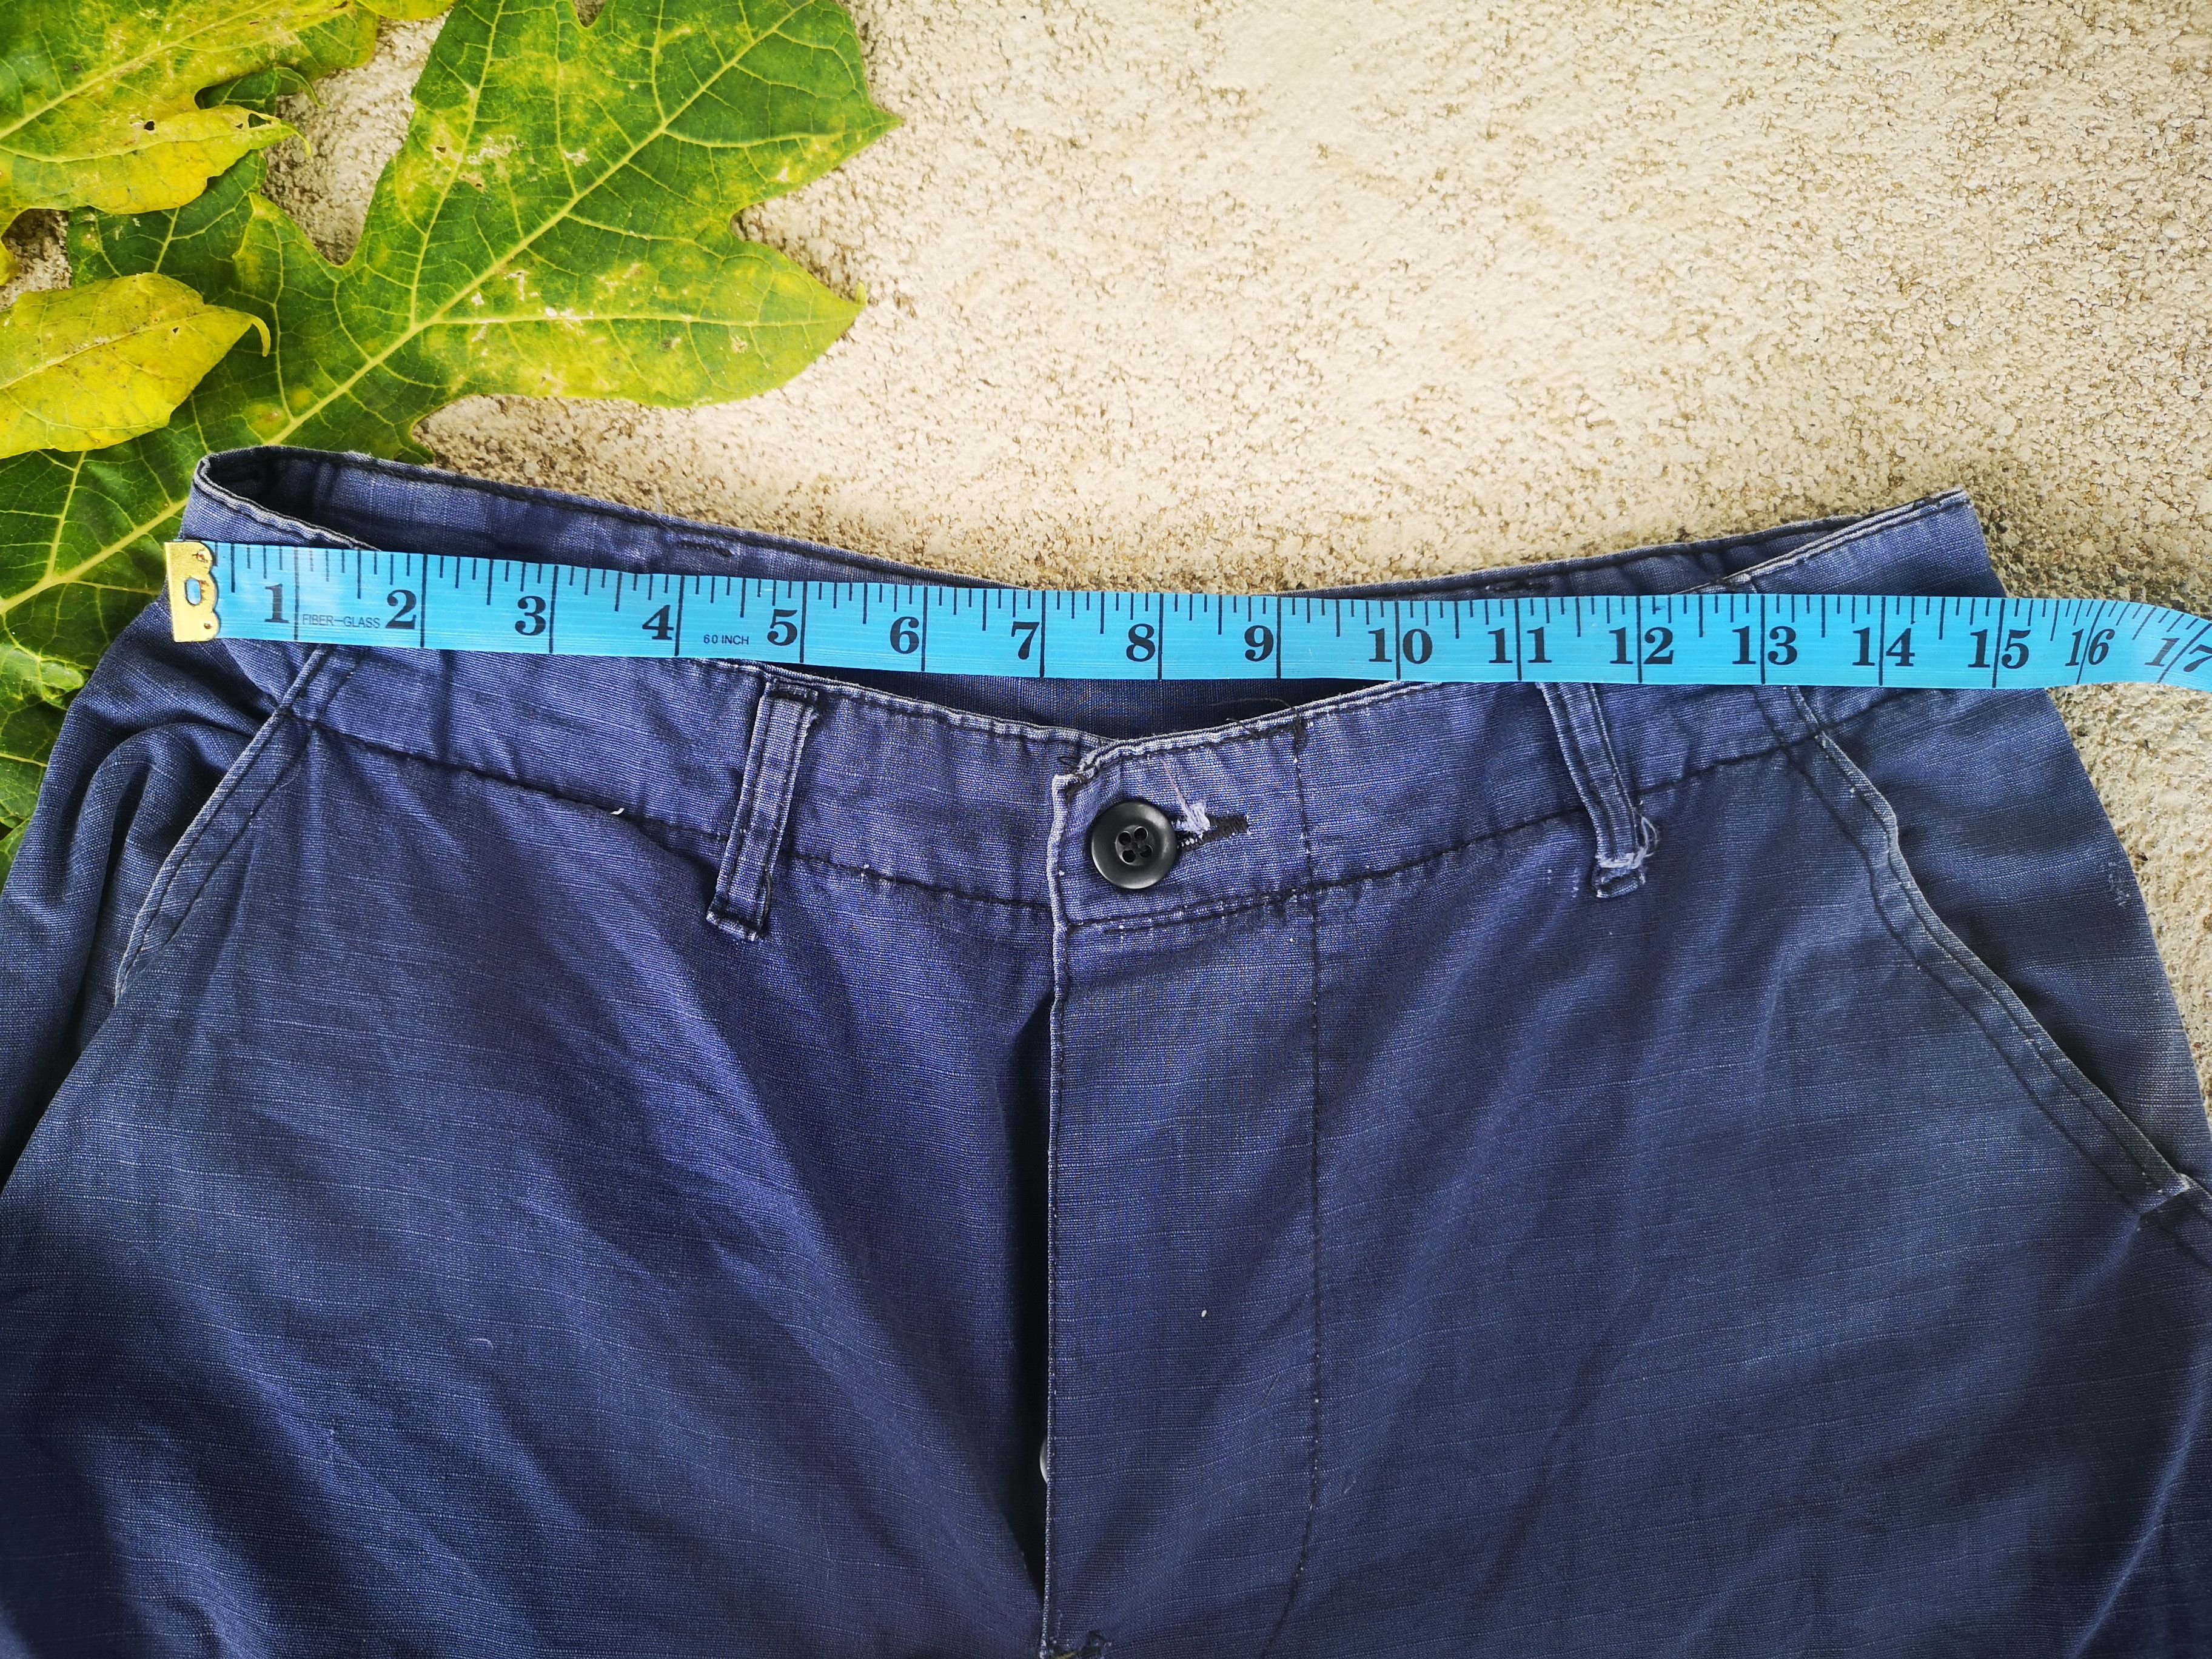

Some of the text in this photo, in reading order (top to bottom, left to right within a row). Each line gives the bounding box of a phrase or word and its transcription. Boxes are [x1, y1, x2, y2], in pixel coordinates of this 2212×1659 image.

[264, 583, 289, 623] 1
[385, 589, 417, 629] 2
[515, 595, 546, 635] 3
[642, 605, 674, 640] 4
[766, 609, 798, 646] 5
[890, 617, 920, 654] 6
[1011, 621, 1039, 660] 7
[1125, 623, 1156, 662] 8
[1244, 625, 1274, 662] 9
[1368, 628, 1433, 665] 10
[1487, 627, 1552, 664] 11
[1609, 626, 1674, 665] 12
[1732, 625, 1798, 666] 13
[1852, 626, 1915, 666] 14
[1968, 629, 2031, 669] 15
[2065, 628, 2116, 666] 16
[302, 614, 380, 629] FIBER-GLASS
[703, 634, 749, 645] 60 INCH
